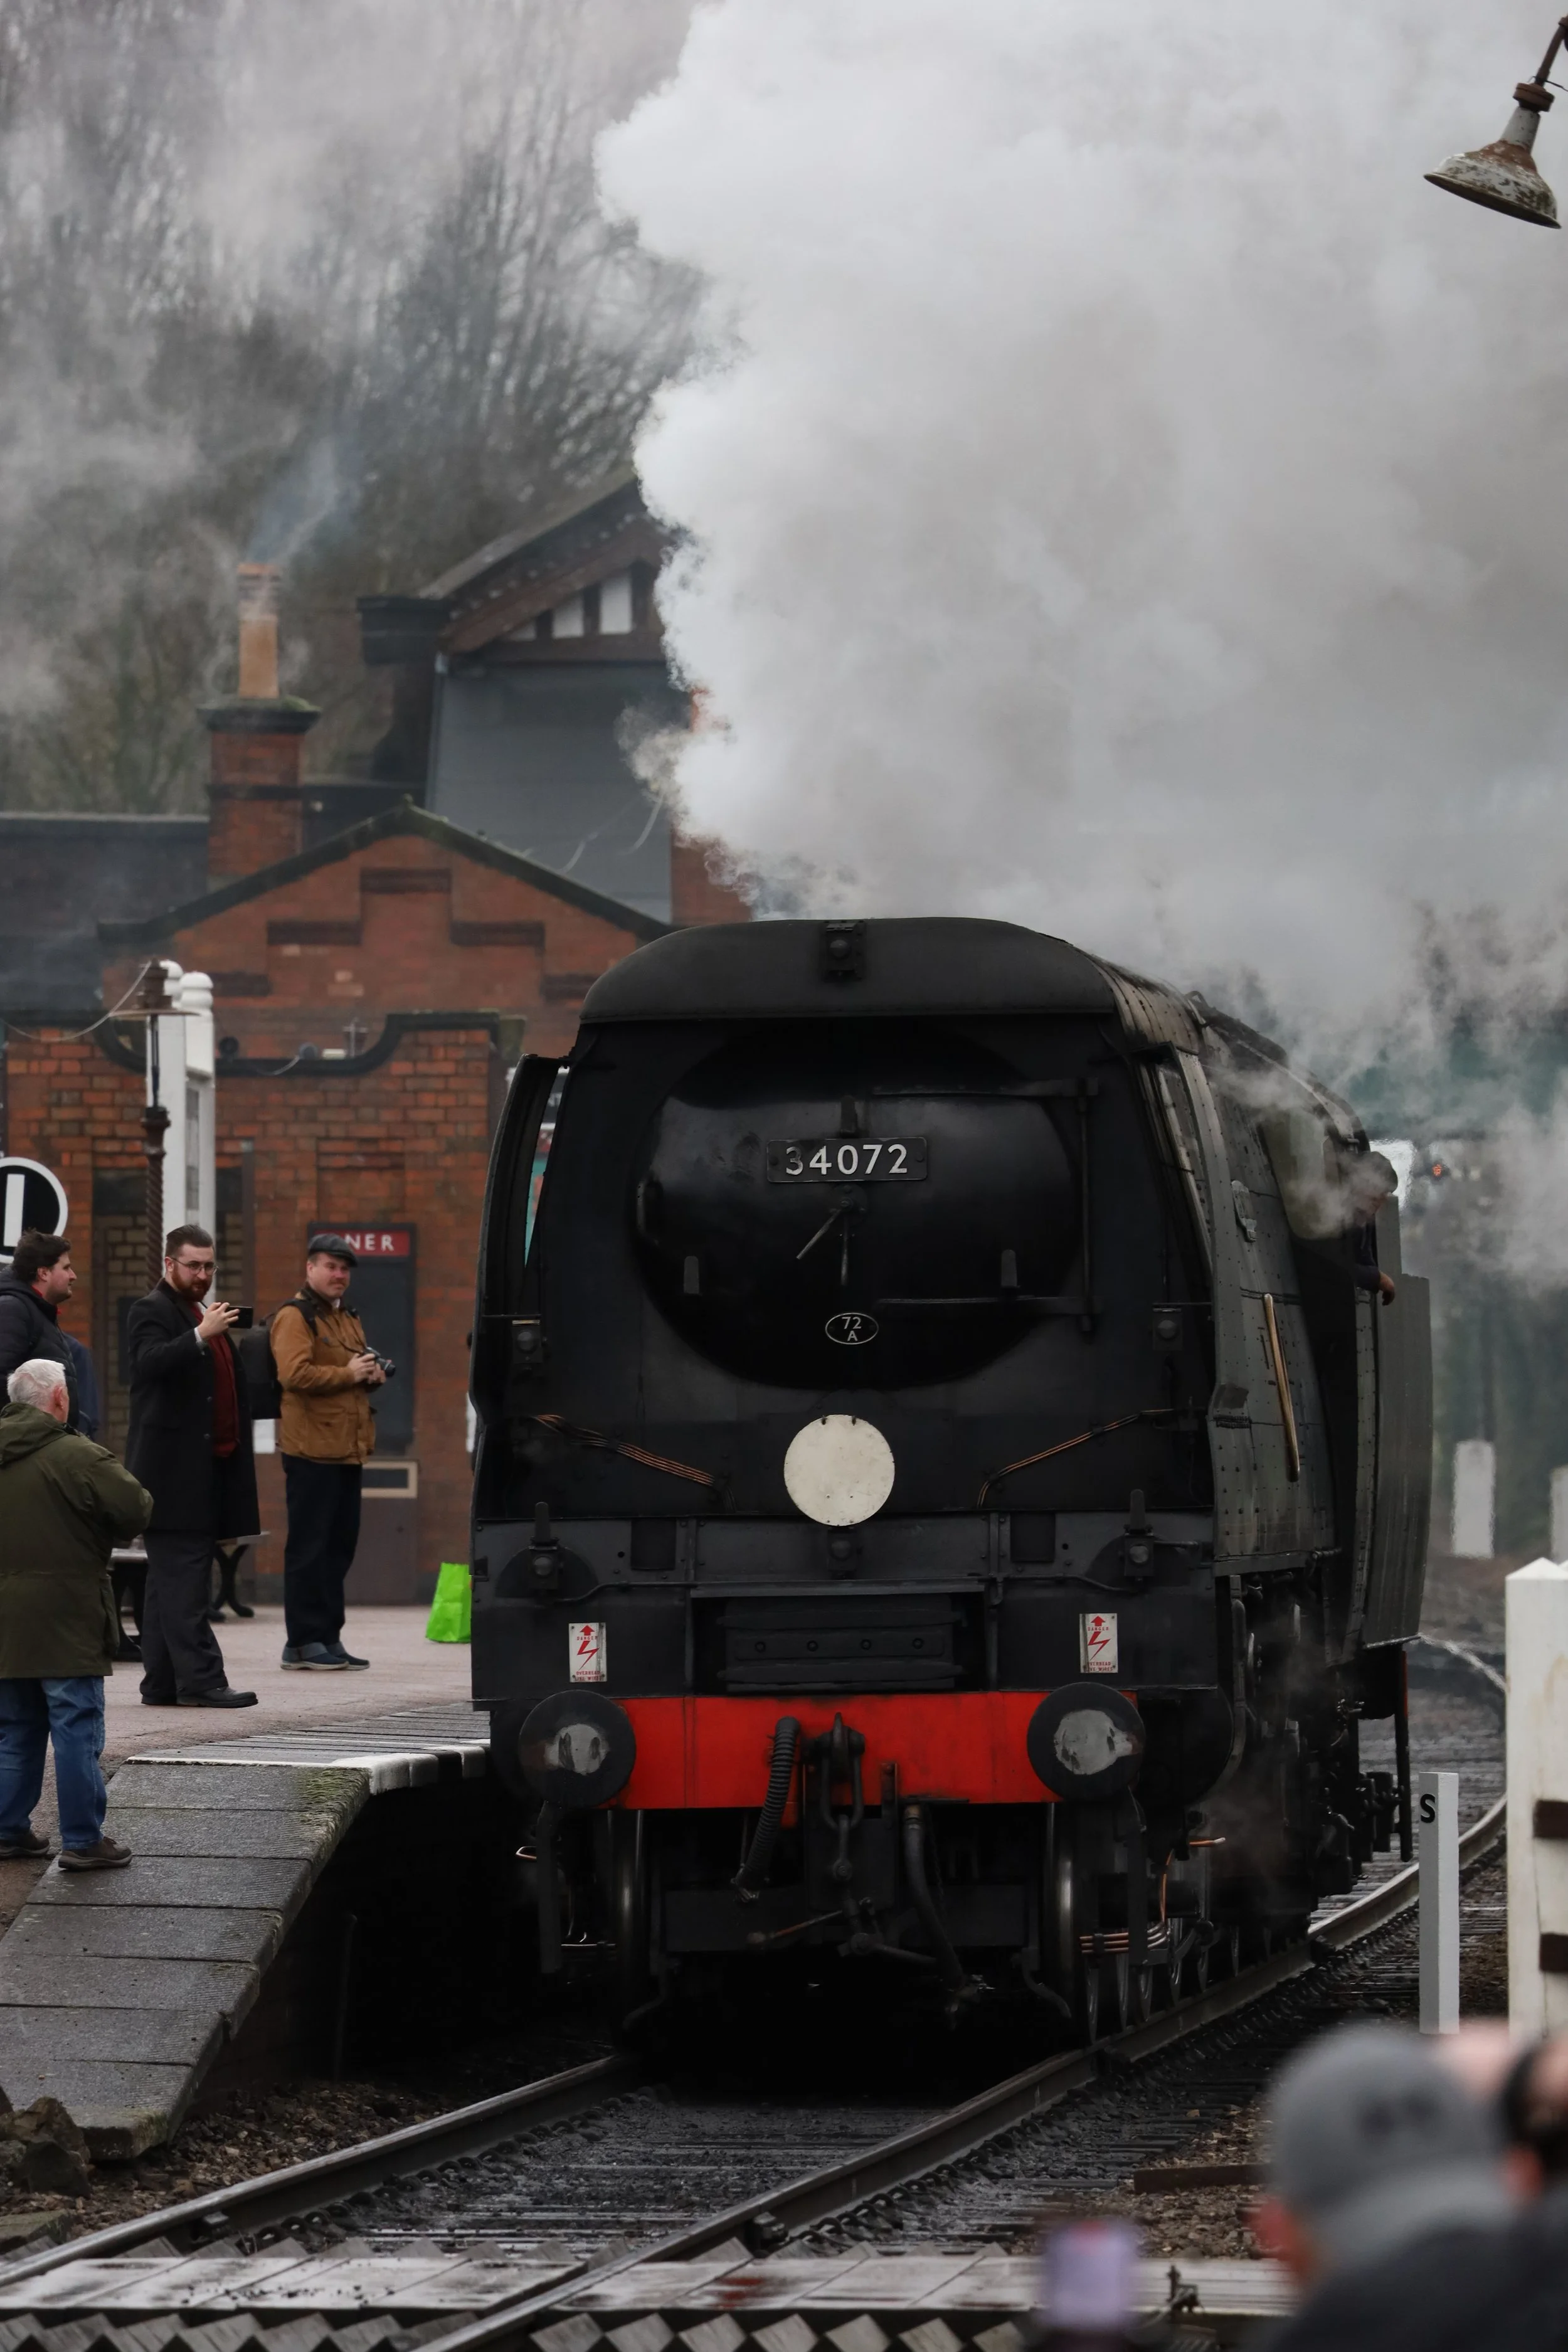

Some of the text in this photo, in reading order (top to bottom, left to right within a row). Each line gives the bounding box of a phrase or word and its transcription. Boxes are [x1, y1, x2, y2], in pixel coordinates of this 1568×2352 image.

[786, 1144, 908, 1175] 34072
[343, 1233, 395, 1252] NER
[842, 1316, 861, 1329] 72
[847, 1330, 857, 1341] A
[1420, 1794, 1435, 1823] S
